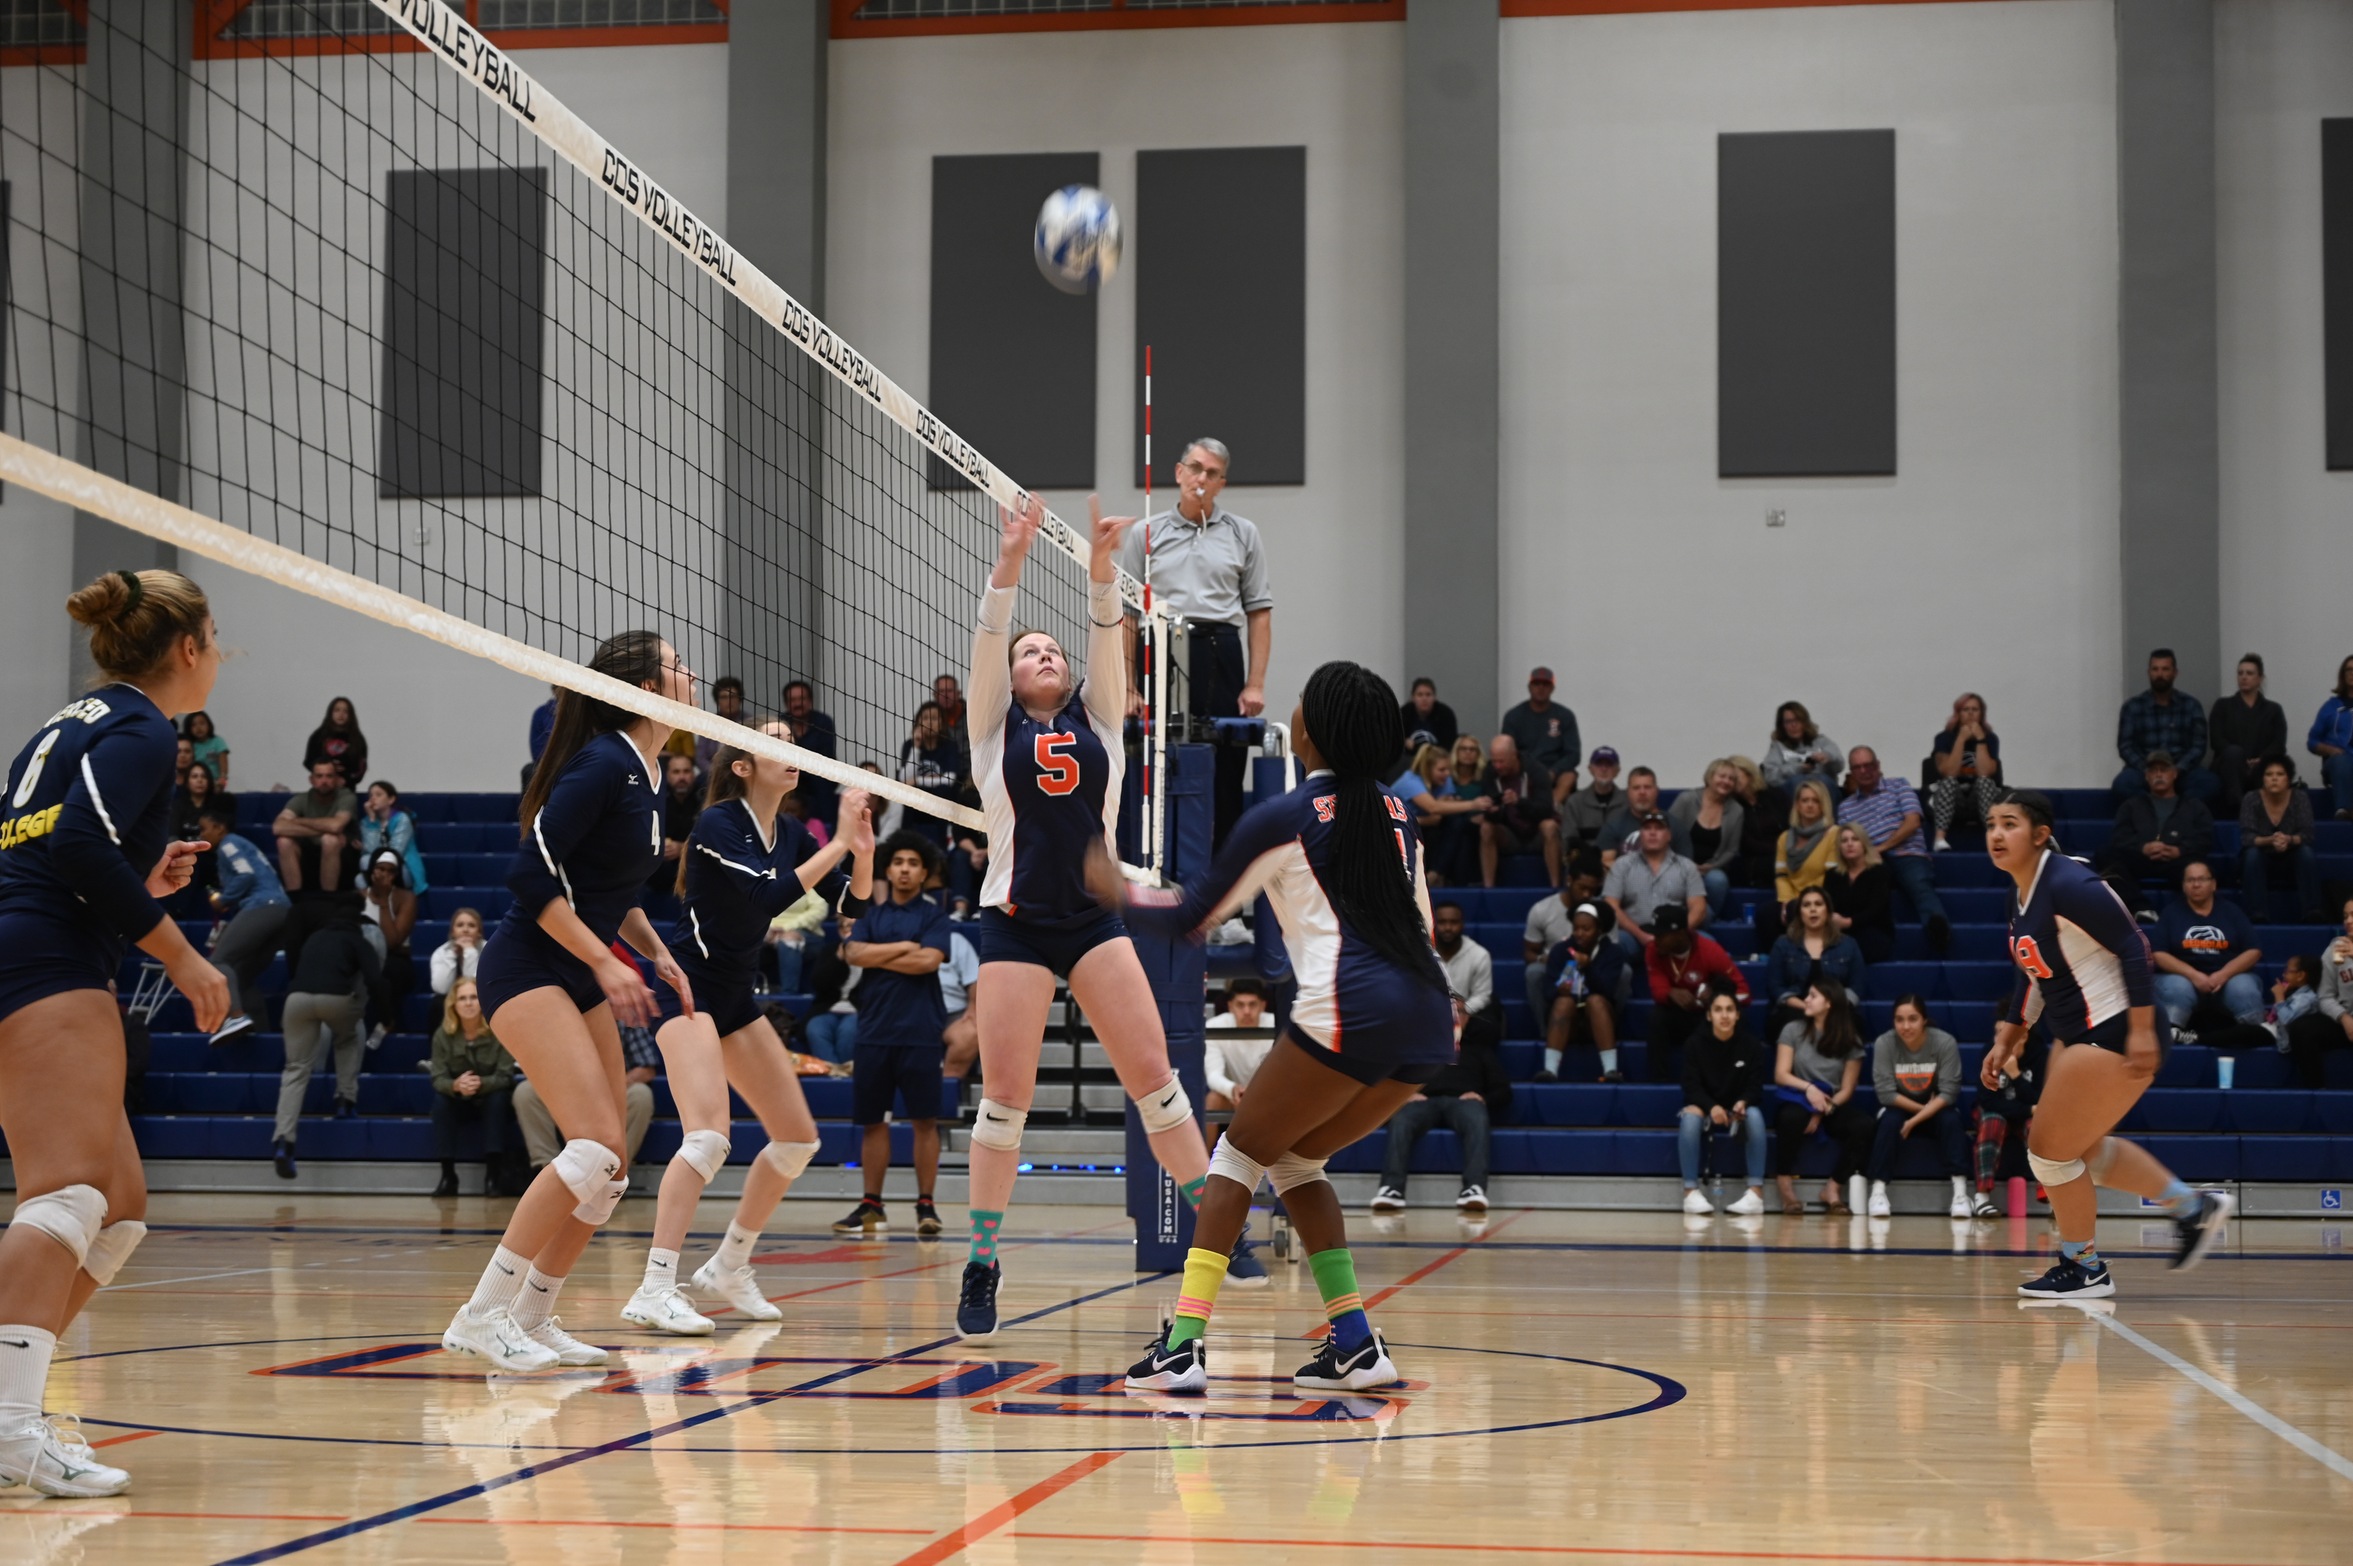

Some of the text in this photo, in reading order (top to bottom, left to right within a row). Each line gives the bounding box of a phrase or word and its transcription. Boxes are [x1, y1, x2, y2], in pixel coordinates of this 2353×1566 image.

[602, 148, 737, 287] COS VOLLEYBALL
[782, 299, 881, 403] COS VOLLEYBALL
[938, 424, 990, 489] VOLLEYBALL
[12, 729, 61, 809] 6
[1034, 731, 1080, 797] 5
[651, 809, 661, 856] 4
